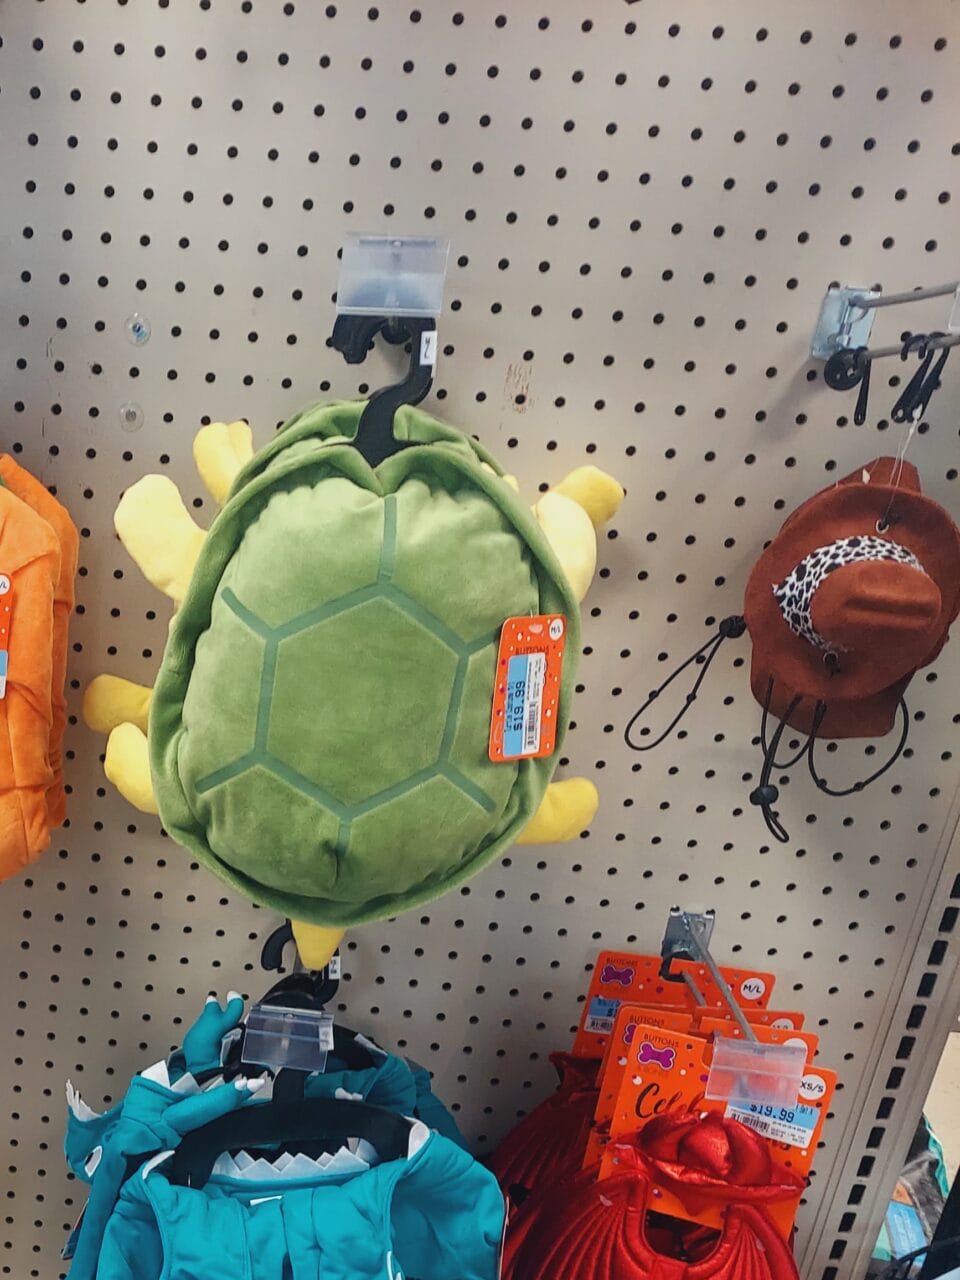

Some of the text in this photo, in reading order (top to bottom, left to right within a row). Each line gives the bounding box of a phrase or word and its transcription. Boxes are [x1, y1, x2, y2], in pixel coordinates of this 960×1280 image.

[742, 983, 762, 993] M/L
[629, 1014, 665, 1026] BUTTONS
[643, 1032, 680, 1048] BUTTONS
[750, 1103, 795, 1123] $19.99
